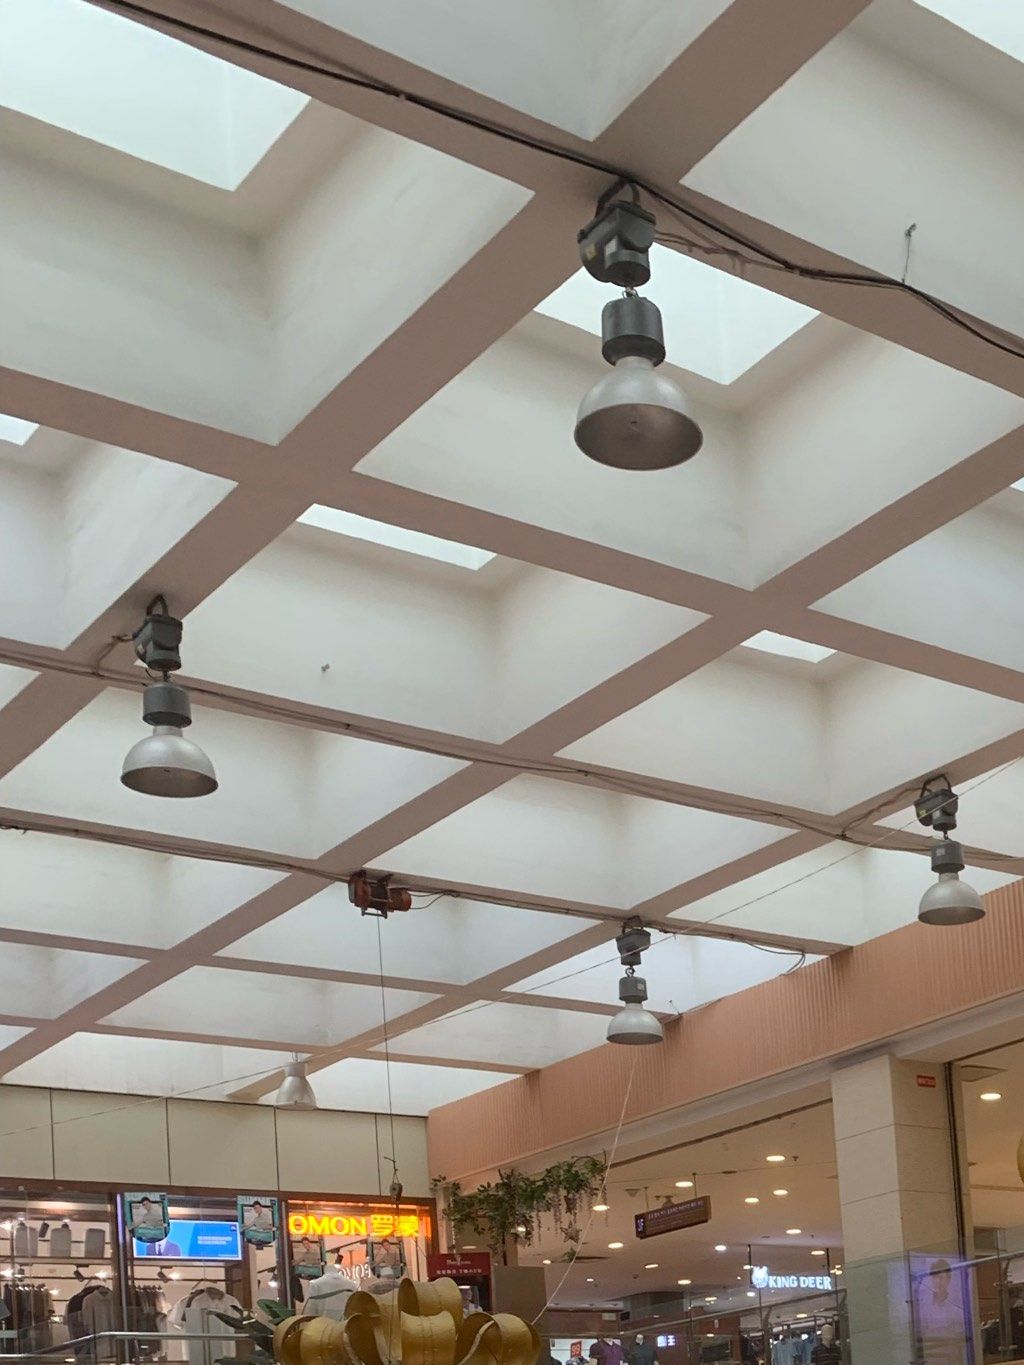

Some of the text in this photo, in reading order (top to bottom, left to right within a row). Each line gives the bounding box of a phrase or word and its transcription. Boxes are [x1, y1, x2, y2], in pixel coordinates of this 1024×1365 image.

[289, 1215, 420, 1238] OMON 罗蒙
[768, 1276, 832, 1291] KING DEER
